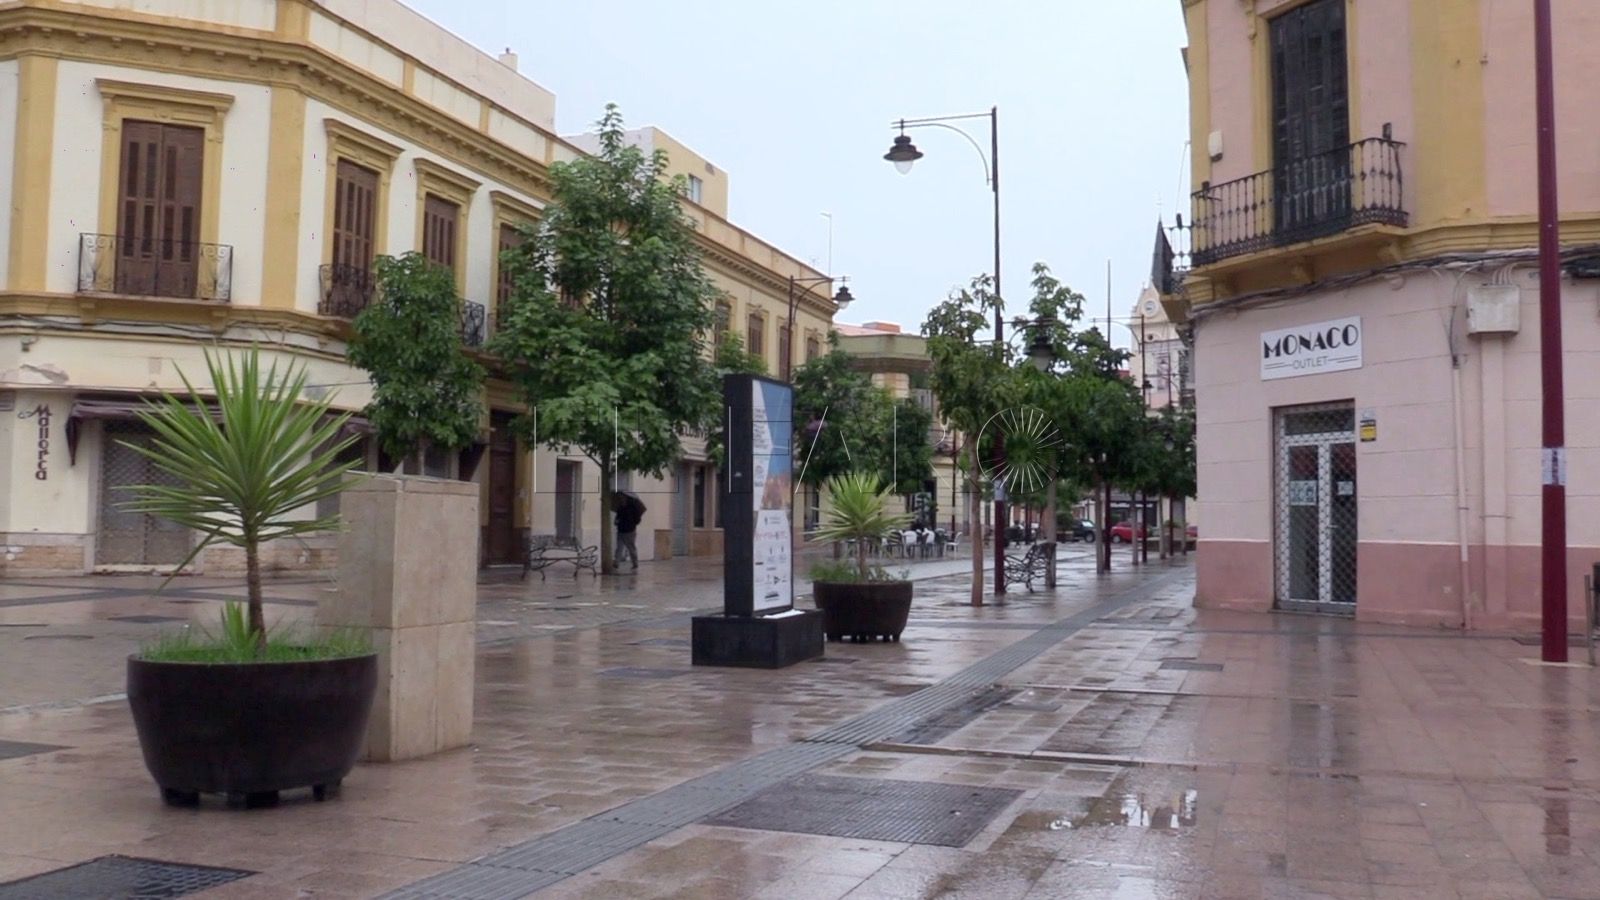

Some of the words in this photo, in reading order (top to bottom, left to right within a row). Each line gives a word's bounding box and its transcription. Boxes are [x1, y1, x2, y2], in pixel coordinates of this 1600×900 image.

[1263, 324, 1359, 359] MONACO
[1292, 356, 1329, 370] OUTLET
[17, 403, 53, 481] Mallorca
